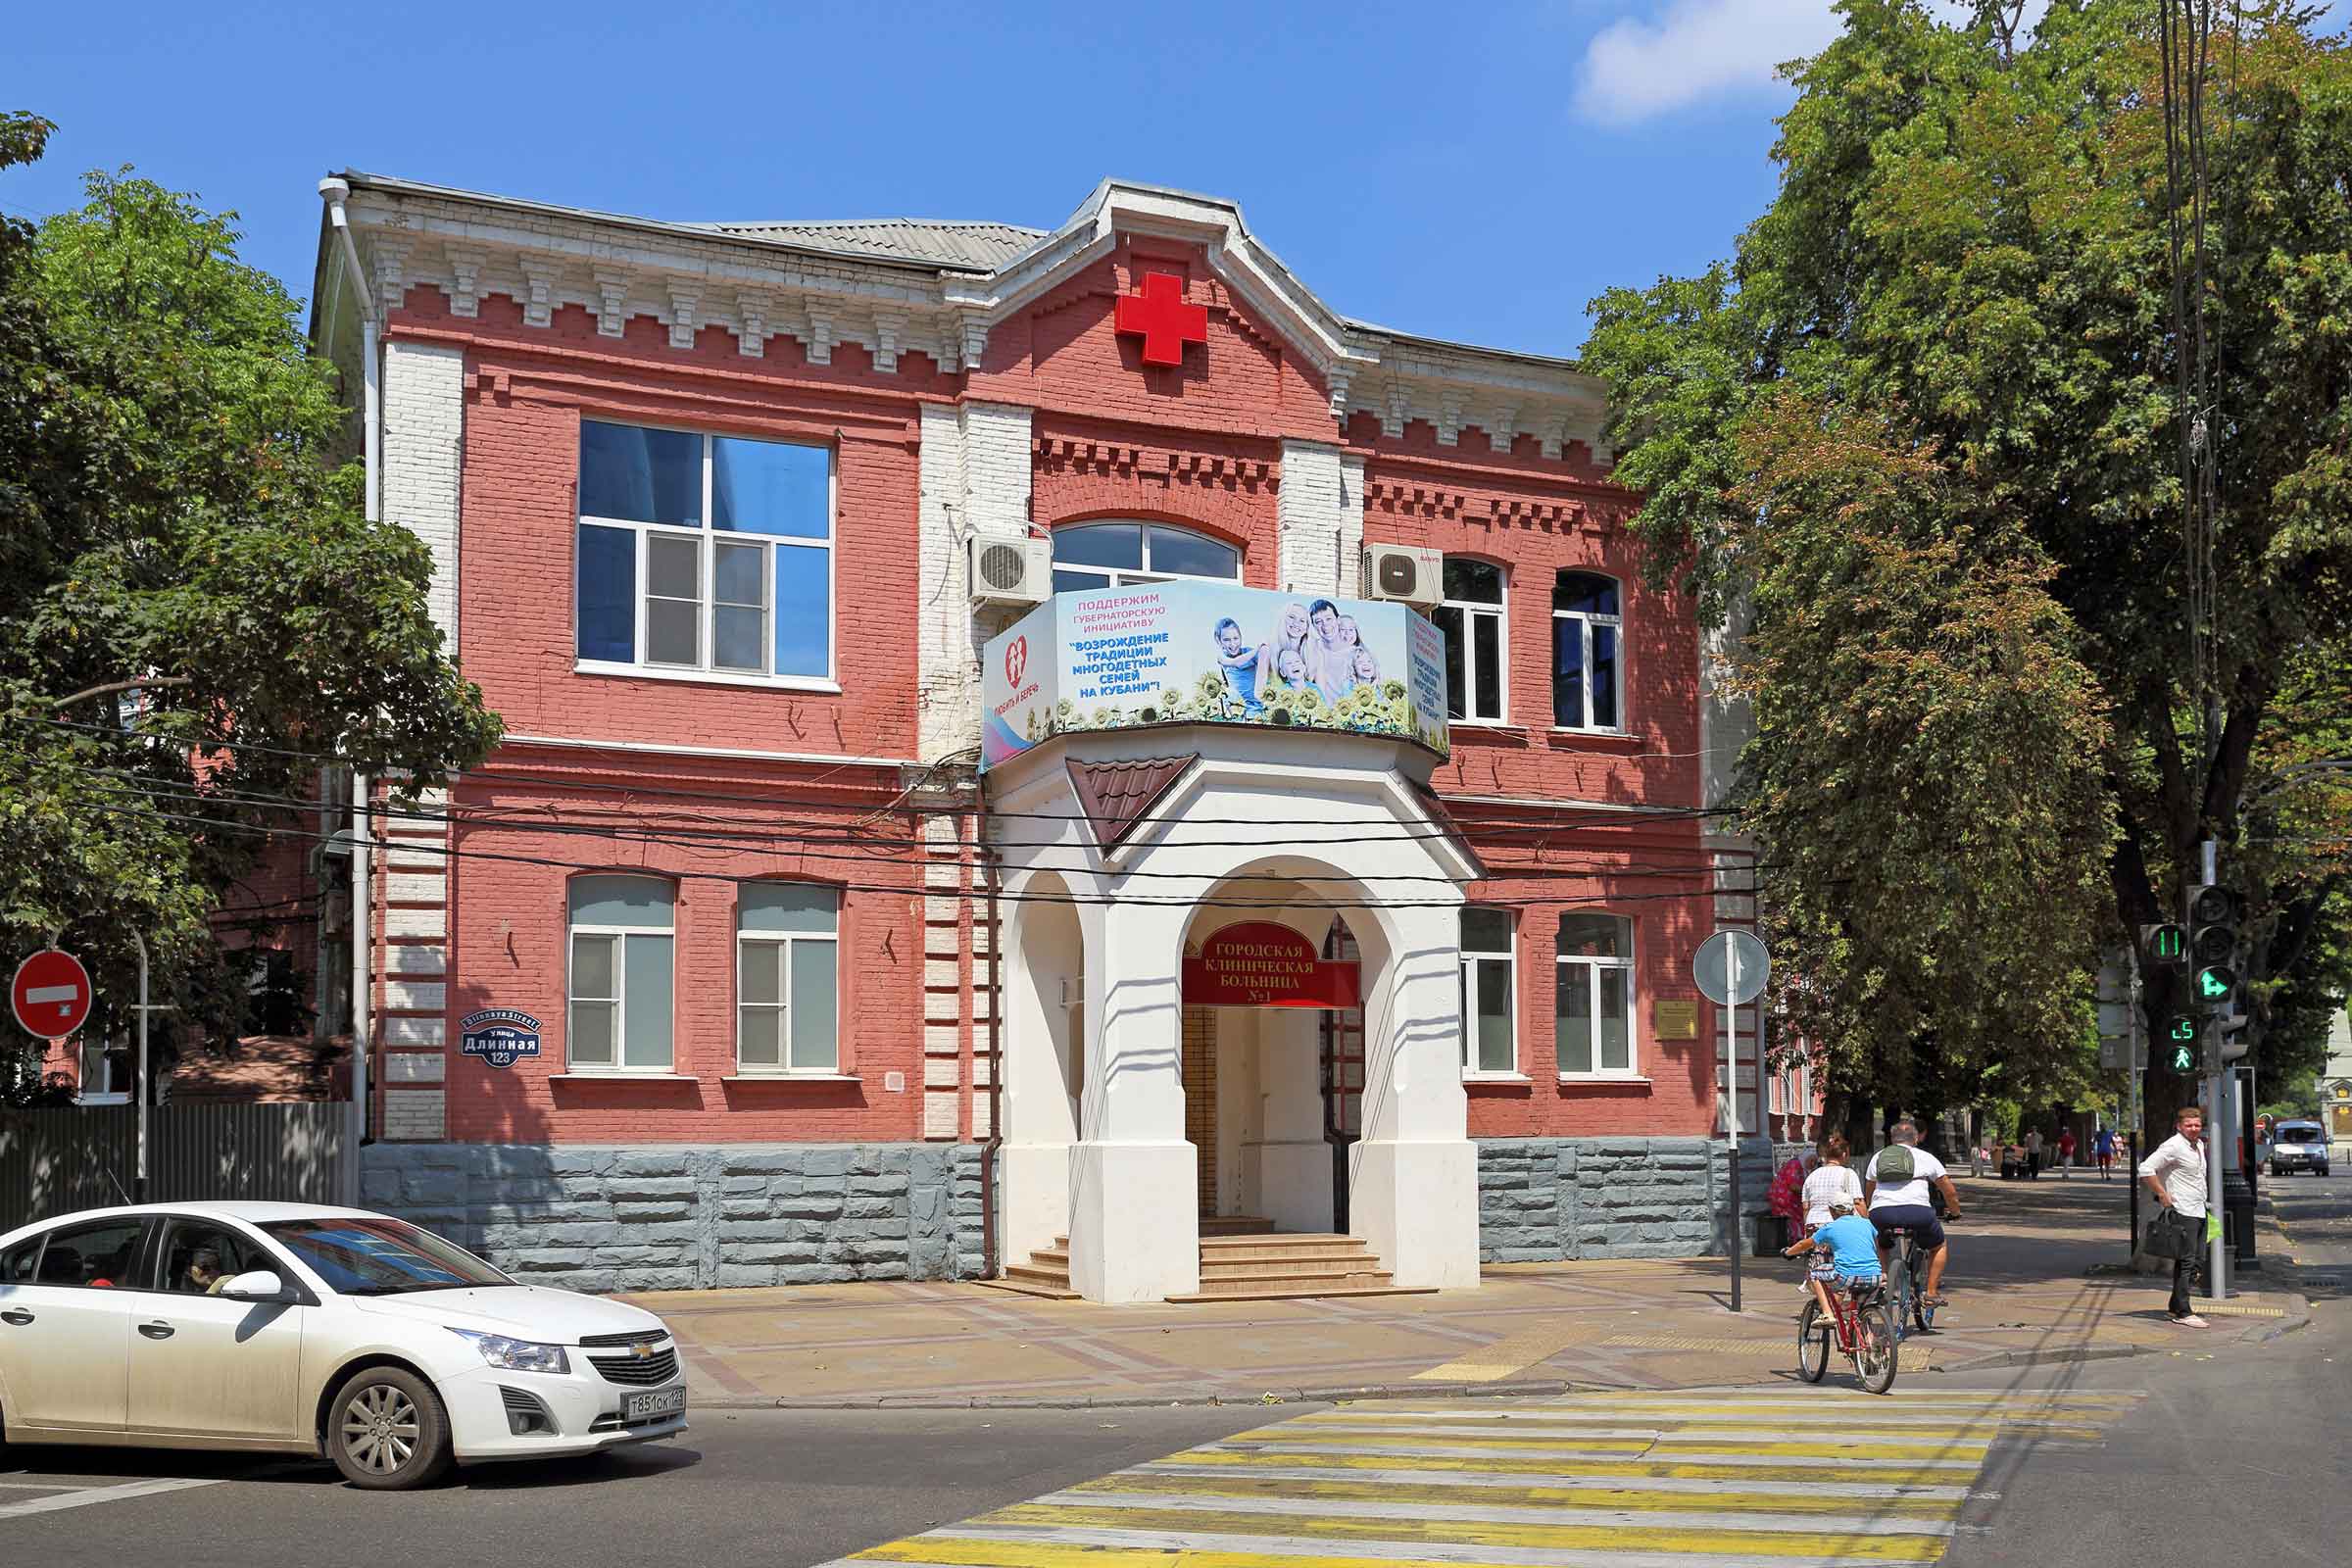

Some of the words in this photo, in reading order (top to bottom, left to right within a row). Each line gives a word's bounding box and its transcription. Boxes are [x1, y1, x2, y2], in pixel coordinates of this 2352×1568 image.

[1078, 594, 1159, 612] ПОДДЕРЖИМ
[1073, 607, 1166, 623] ГУБЕРНАТОРСКУЮ
[1083, 618, 1154, 633] ИНИЦИАТИВУ
[1085, 647, 1153, 662] ТРАДИЦИИ
[1072, 657, 1167, 674] МНОГОДЕТНЫХ
[1100, 668, 1140, 684] СЕМЕЙ
[1080, 688, 1098, 698] НА
[1216, 943, 1302, 956] ГОРОДСКАЯ
[1205, 959, 1313, 973] КЛИНИЧЕСКАЯ
[1221, 974, 1299, 989] БОЛЬНИЦА
[508, 1010, 536, 1027] Street
[465, 1038, 536, 1052] Длинная
[491, 1052, 510, 1063] 123
